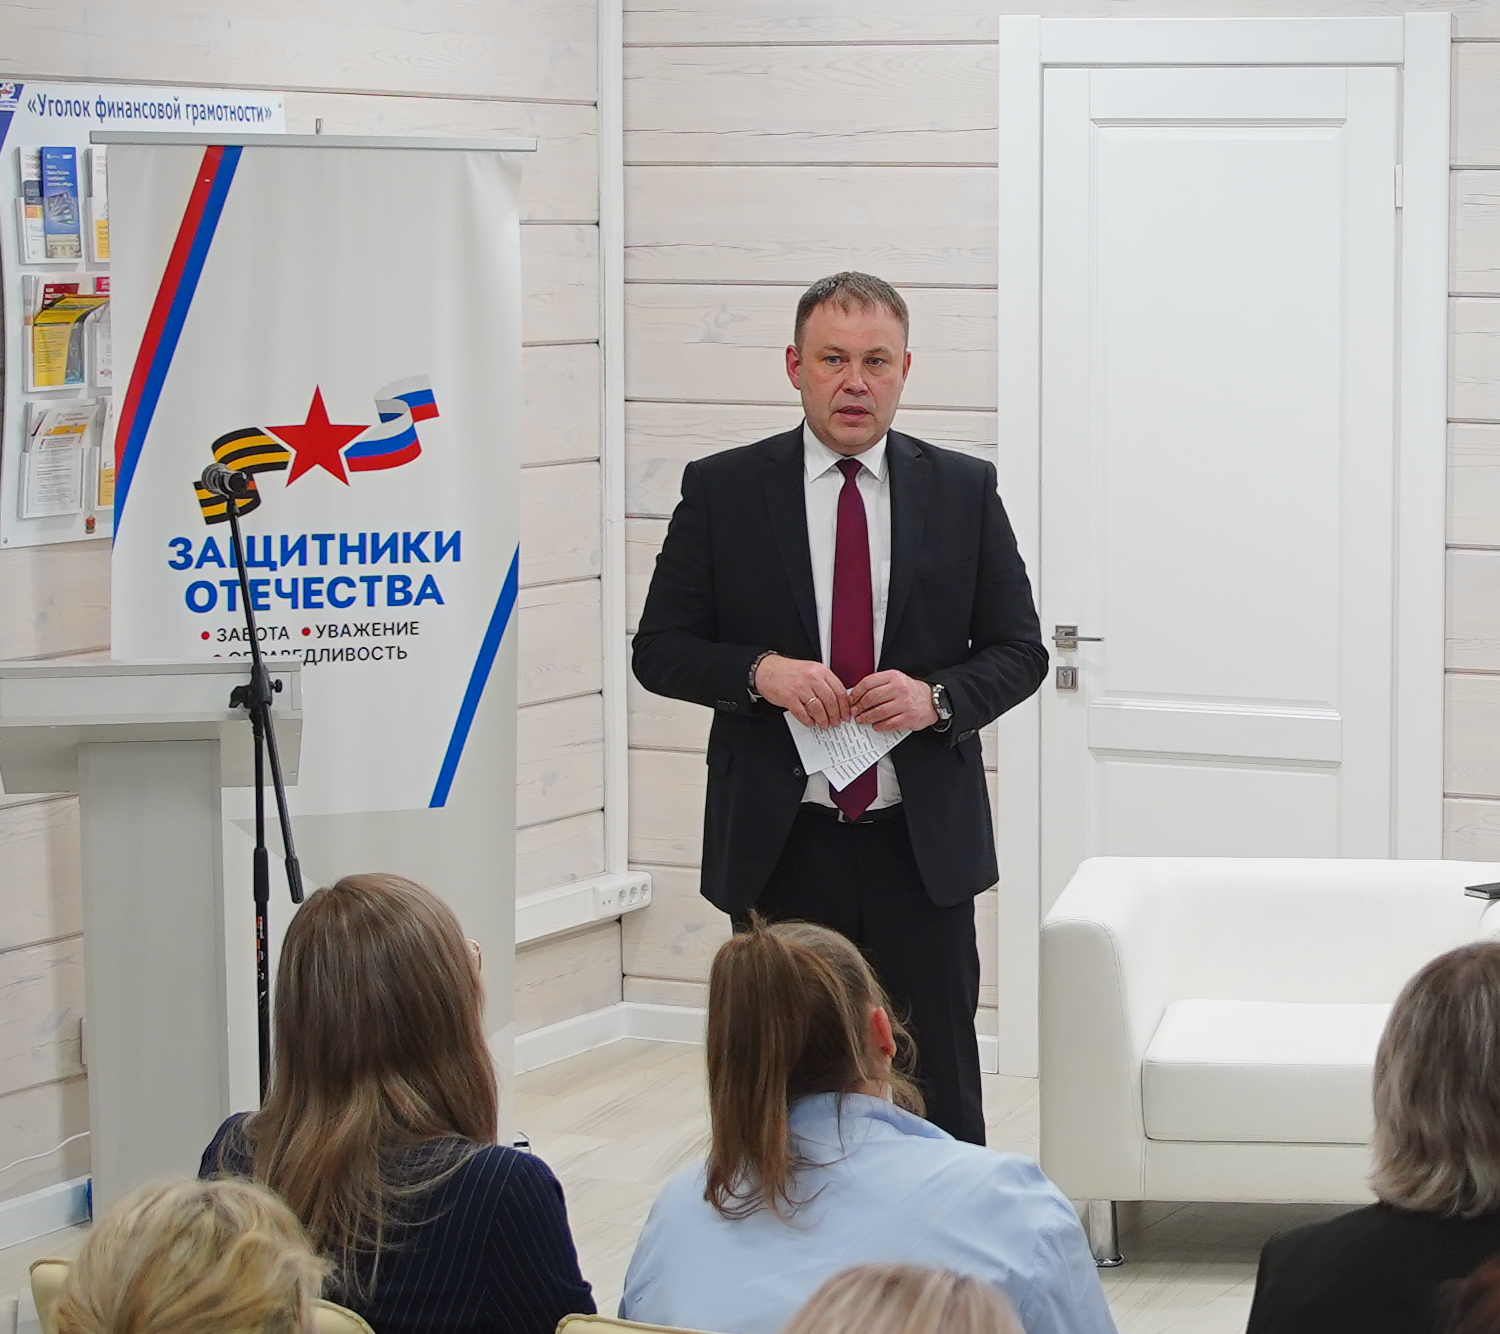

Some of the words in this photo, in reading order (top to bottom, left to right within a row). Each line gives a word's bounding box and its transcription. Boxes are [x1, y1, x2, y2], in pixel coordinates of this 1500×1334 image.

[28, 93, 90, 118] «Уголок
[95, 95, 182, 123] финансовой
[185, 103, 272, 125] грамотности»
[167, 531, 462, 571] ЗАЩИТНИКИ
[185, 574, 446, 613] ОТЕЧЕСТВА
[315, 621, 420, 638] УВАЖЕНИЕ
[229, 646, 408, 666] ДЛИВОСТЬ
